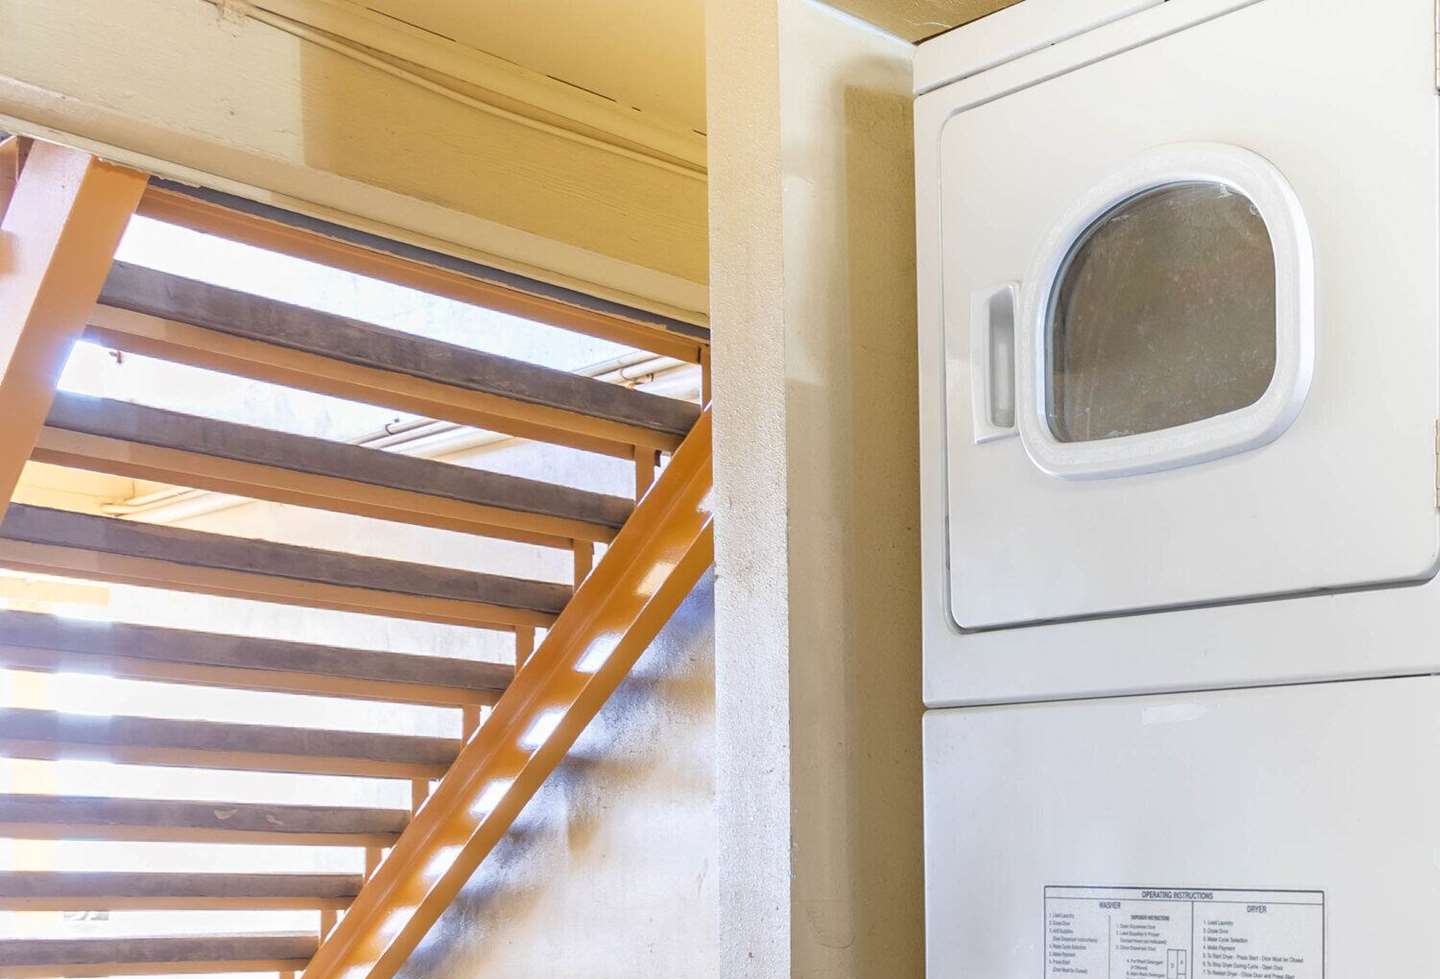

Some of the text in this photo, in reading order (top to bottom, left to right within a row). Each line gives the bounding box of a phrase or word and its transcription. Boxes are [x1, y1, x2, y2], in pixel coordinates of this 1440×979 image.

[1141, 890, 1214, 900] OPERATING INSTRUCTIONS
[1246, 904, 1267, 914] DRYER
